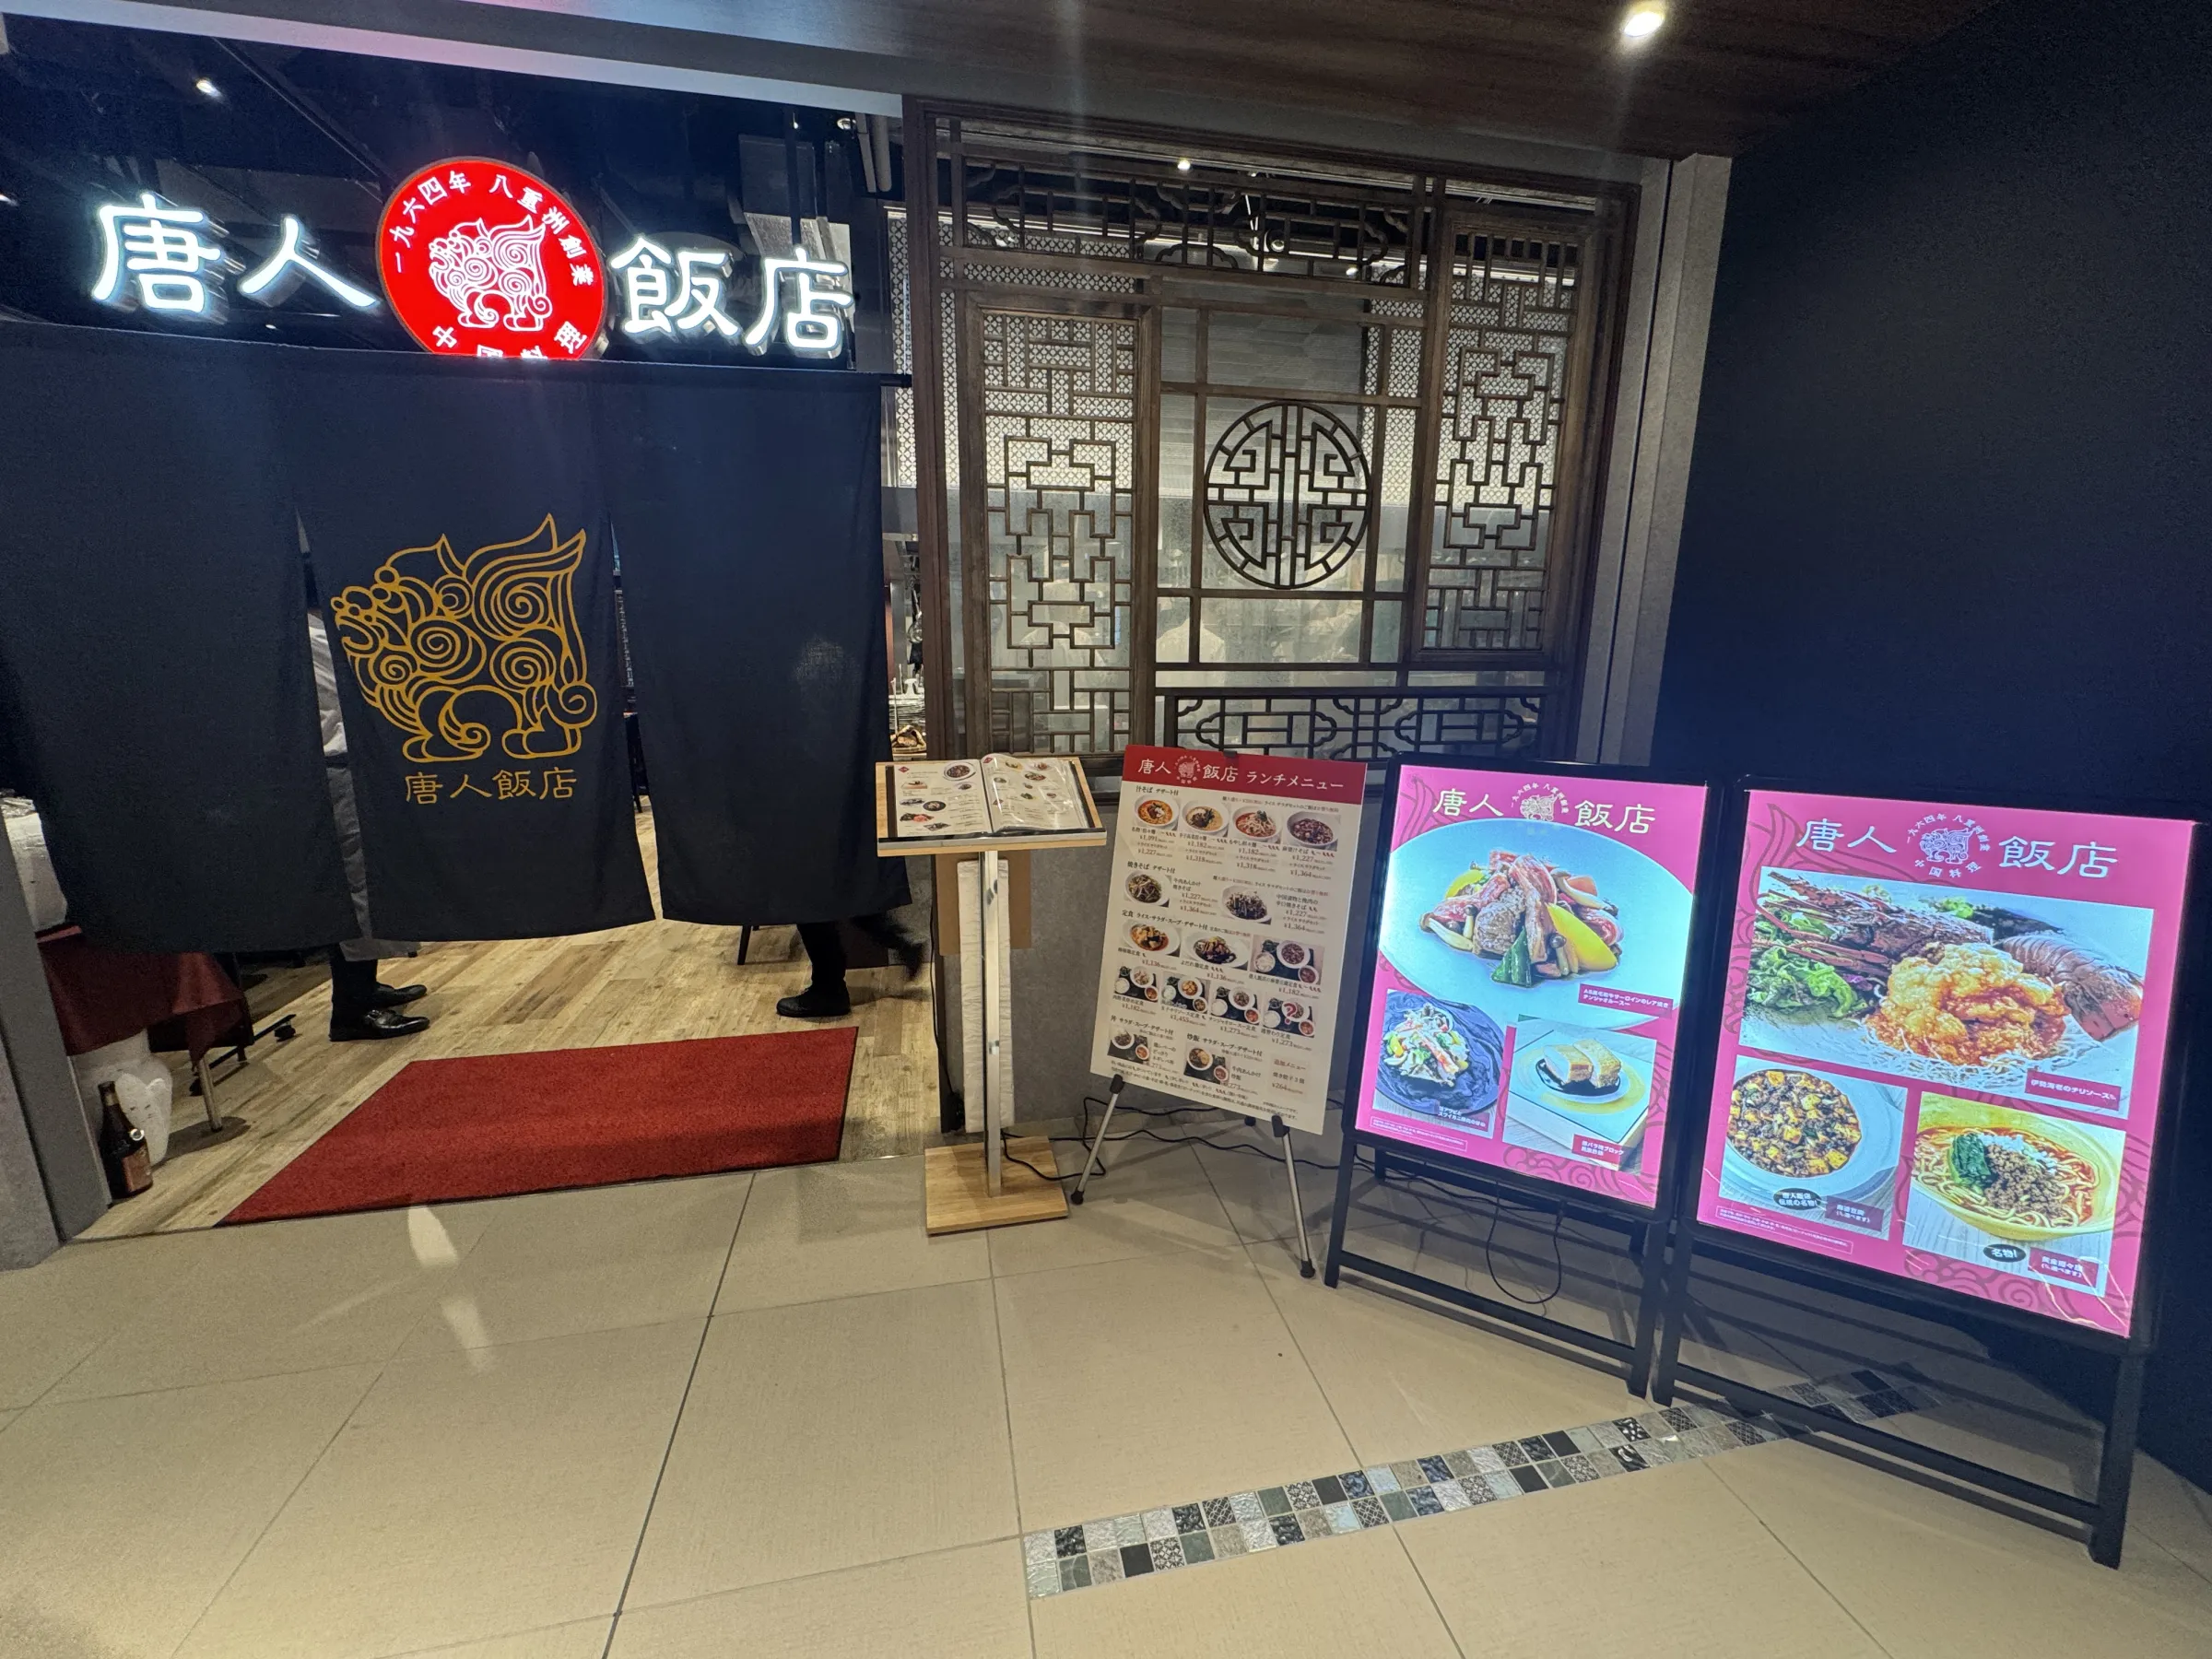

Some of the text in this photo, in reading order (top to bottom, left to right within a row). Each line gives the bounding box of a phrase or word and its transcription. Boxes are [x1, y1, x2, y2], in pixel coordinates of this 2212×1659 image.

[91, 190, 855, 350] 唐人 飯店
[405, 767, 578, 805] 唐人飯店
[1137, 759, 1171, 775] 唐人
[1202, 764, 1239, 782] 飯店
[1246, 771, 1344, 790] ランチメニュー
[1432, 787, 1504, 817] 唐人
[1573, 799, 1655, 834] 飯店
[1795, 818, 2118, 878] 唐人 飯店
[2030, 1079, 2110, 1100] 伊勢海老のチリソース
